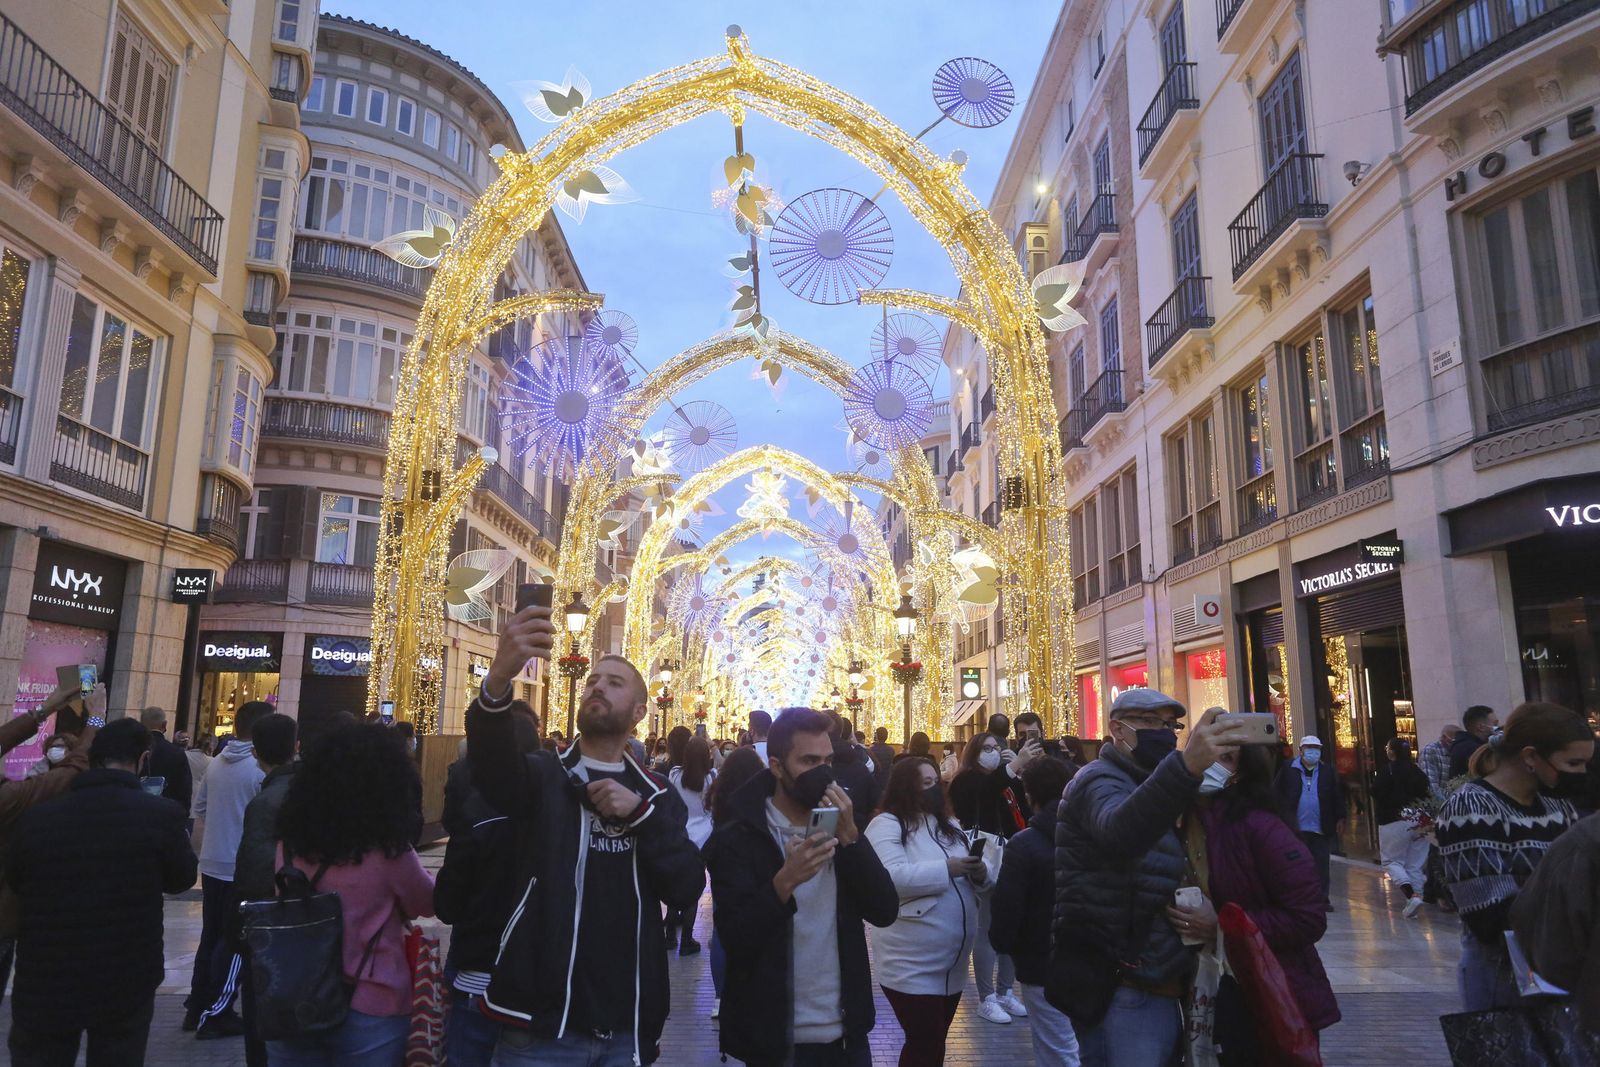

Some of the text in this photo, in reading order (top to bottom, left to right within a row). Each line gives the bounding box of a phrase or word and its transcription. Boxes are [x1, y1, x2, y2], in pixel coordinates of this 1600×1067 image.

[1445, 105, 1596, 201] HOTE
[1545, 503, 1600, 527] VIC
[51, 565, 102, 596] NYX
[176, 576, 207, 586] NYX
[1300, 567, 1353, 593] VICTORIA'S
[88, 604, 115, 614] MAKEUP
[311, 647, 373, 663] Desigual
[31, 684, 57, 694] FRIDA
